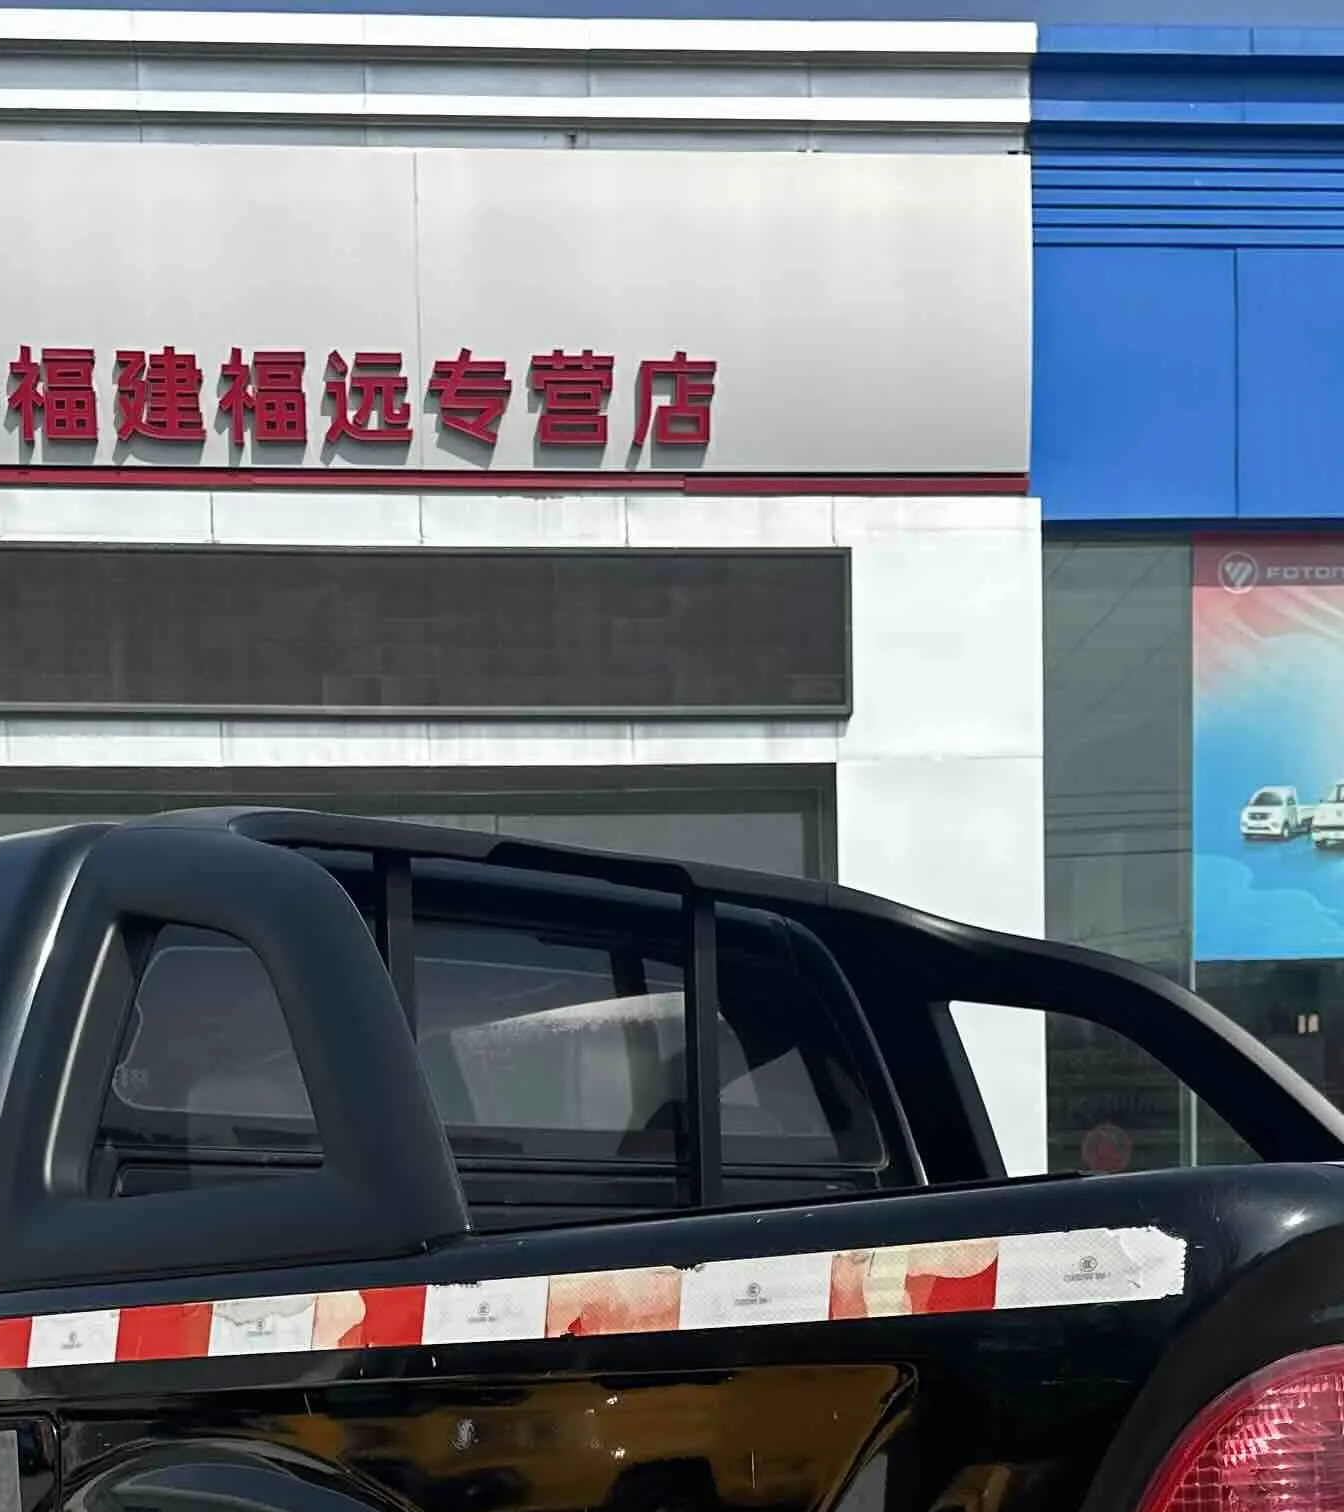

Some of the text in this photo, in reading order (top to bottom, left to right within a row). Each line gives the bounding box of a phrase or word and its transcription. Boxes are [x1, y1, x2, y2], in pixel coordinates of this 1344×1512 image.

[8, 345, 717, 446] 福建福远专营店
